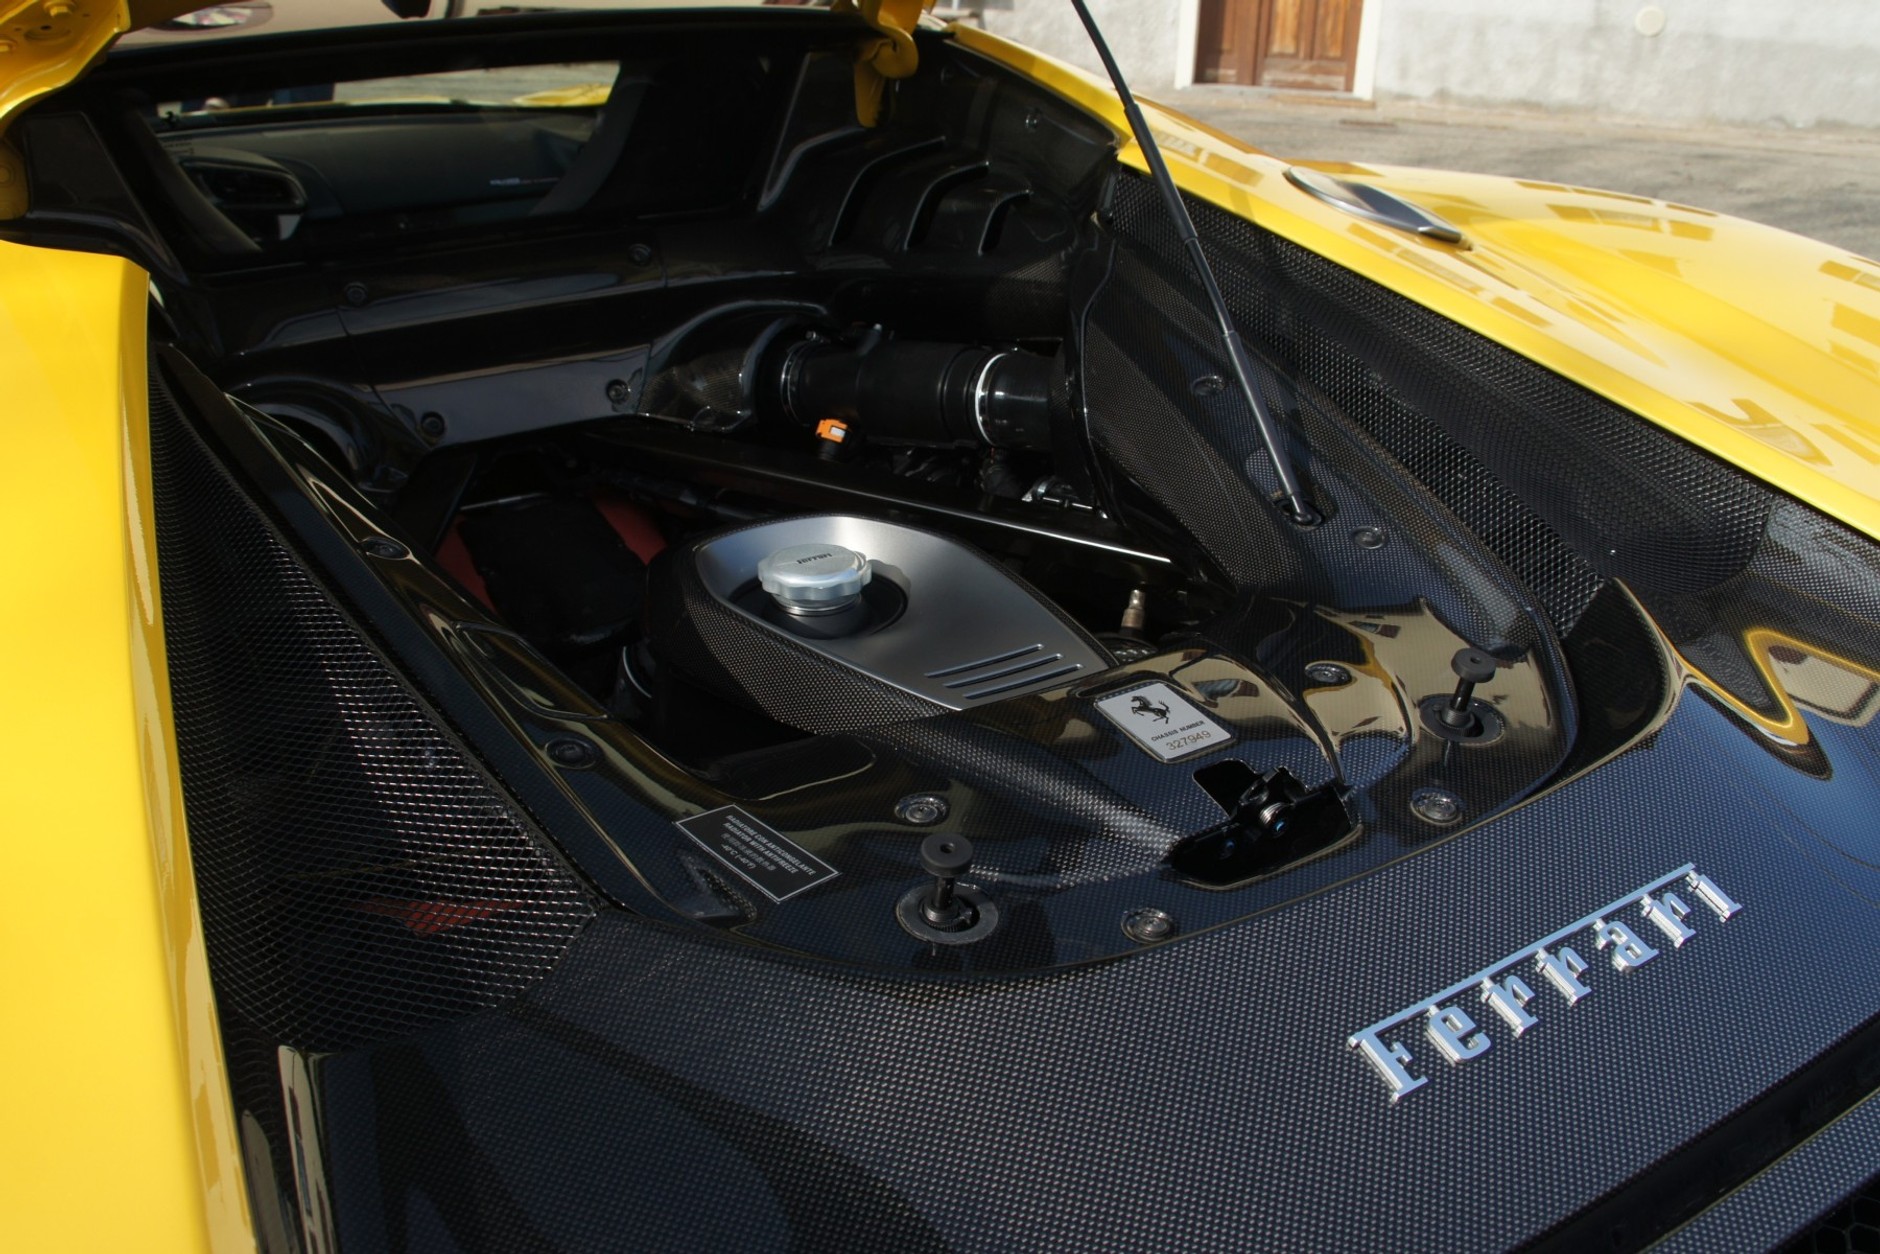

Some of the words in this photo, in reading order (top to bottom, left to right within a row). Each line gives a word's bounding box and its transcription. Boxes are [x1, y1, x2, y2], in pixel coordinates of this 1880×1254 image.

[1151, 728, 1179, 741] CHASSIS
[1179, 720, 1205, 732] NUMBER
[1166, 730, 1211, 750] 327949
[725, 815, 758, 836] RADIATORE
[755, 834, 769, 844] CON
[723, 822, 752, 842] RADIATOR
[750, 840, 766, 852] WITH
[763, 850, 799, 874] ANTIFREEZE
[1347, 862, 1743, 1102] Ferrari
